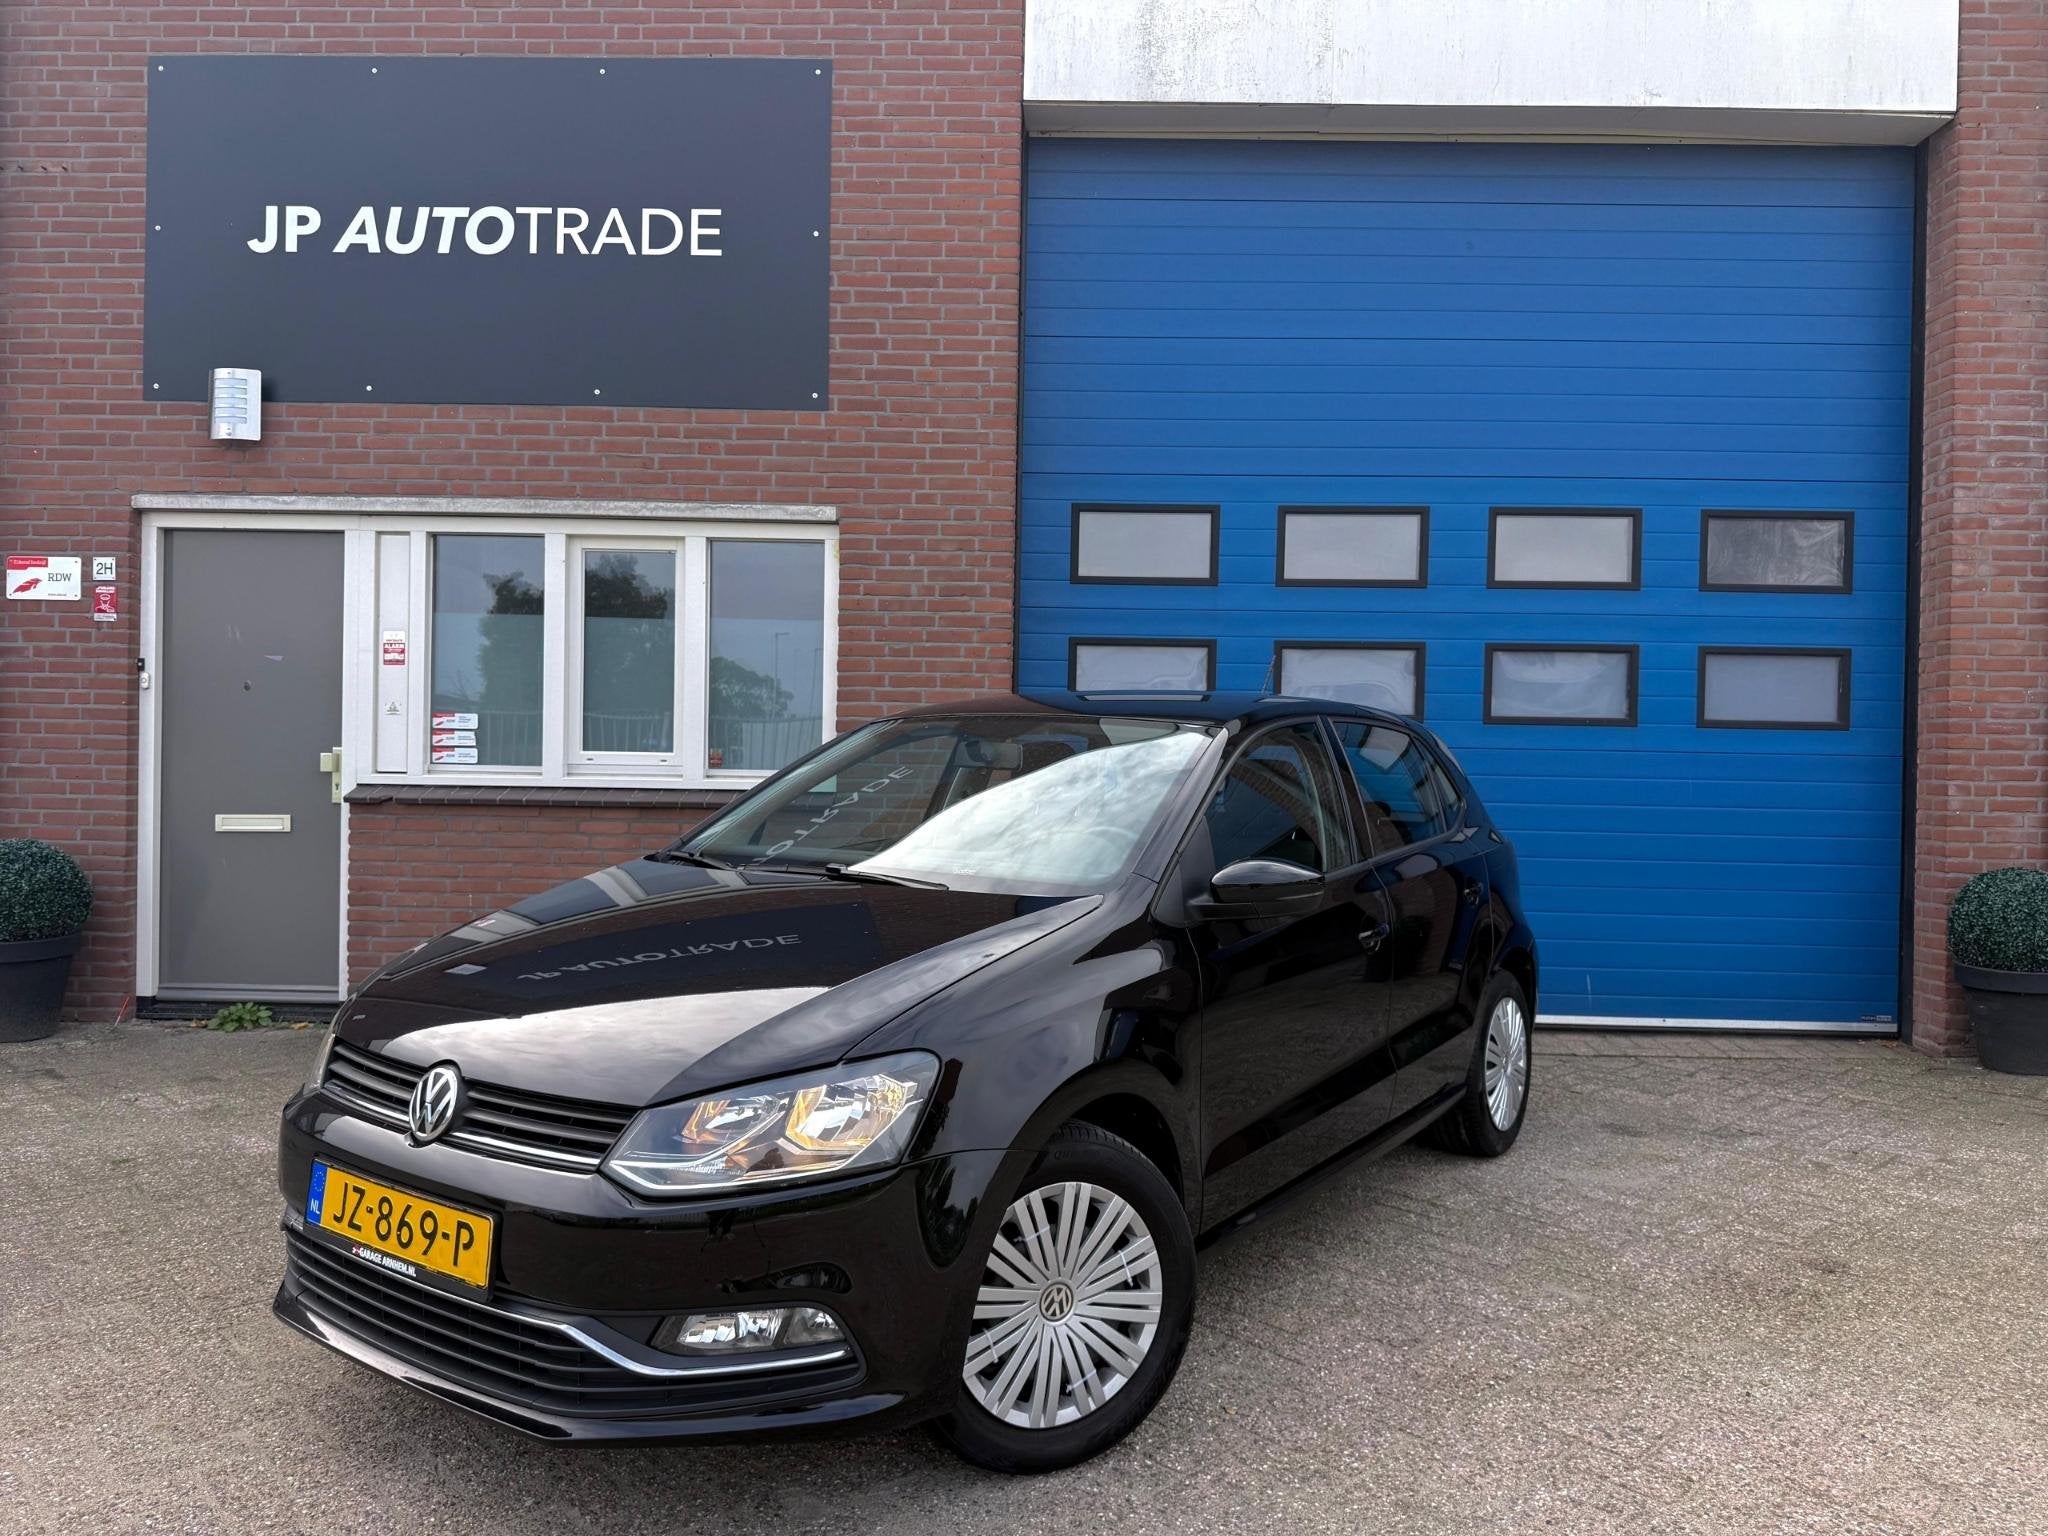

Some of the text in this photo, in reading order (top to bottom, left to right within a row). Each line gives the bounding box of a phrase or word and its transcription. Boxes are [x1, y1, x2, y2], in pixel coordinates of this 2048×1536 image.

[246, 205, 723, 256] JP AUTOTRADE
[47, 572, 72, 582] RDW
[96, 562, 113, 575] 2H
[310, 1198, 321, 1215] NL
[333, 1181, 475, 1267] JZ-869-P
